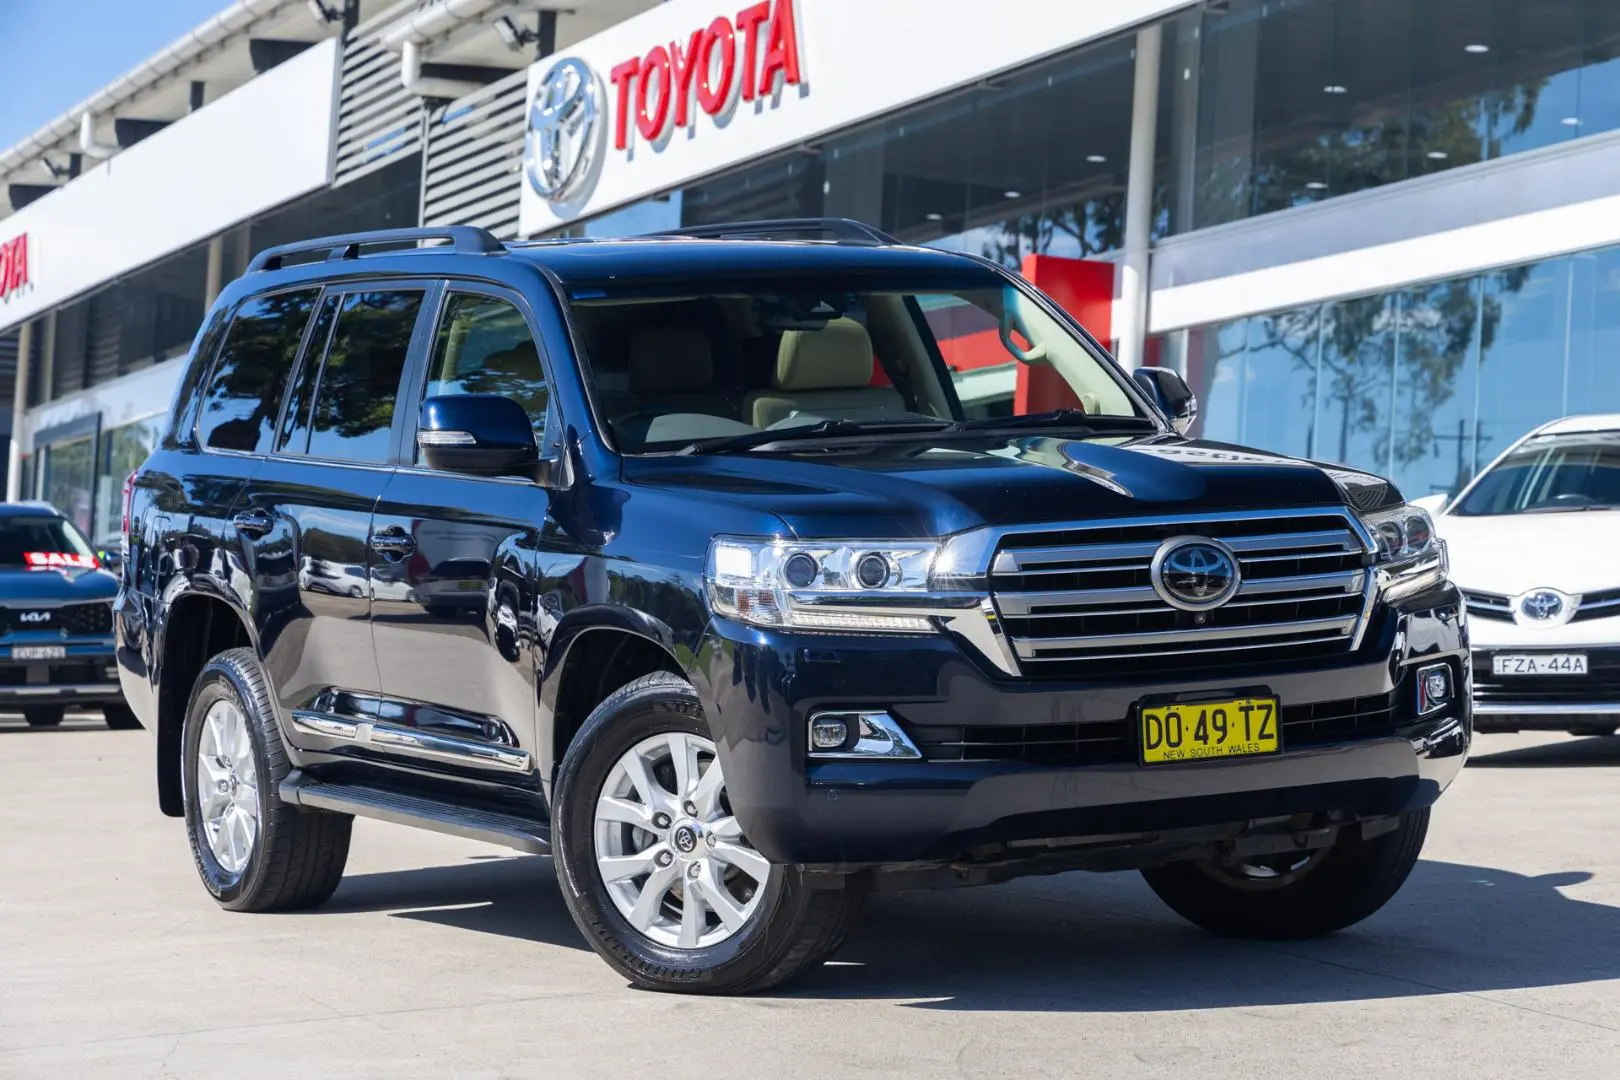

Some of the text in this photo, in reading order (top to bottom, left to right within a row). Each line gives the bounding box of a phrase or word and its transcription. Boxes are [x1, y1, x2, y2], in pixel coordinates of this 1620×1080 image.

[611, 0, 800, 150] TOYOTA
[1163, 743, 1260, 761] NEW SOUTH WALES
